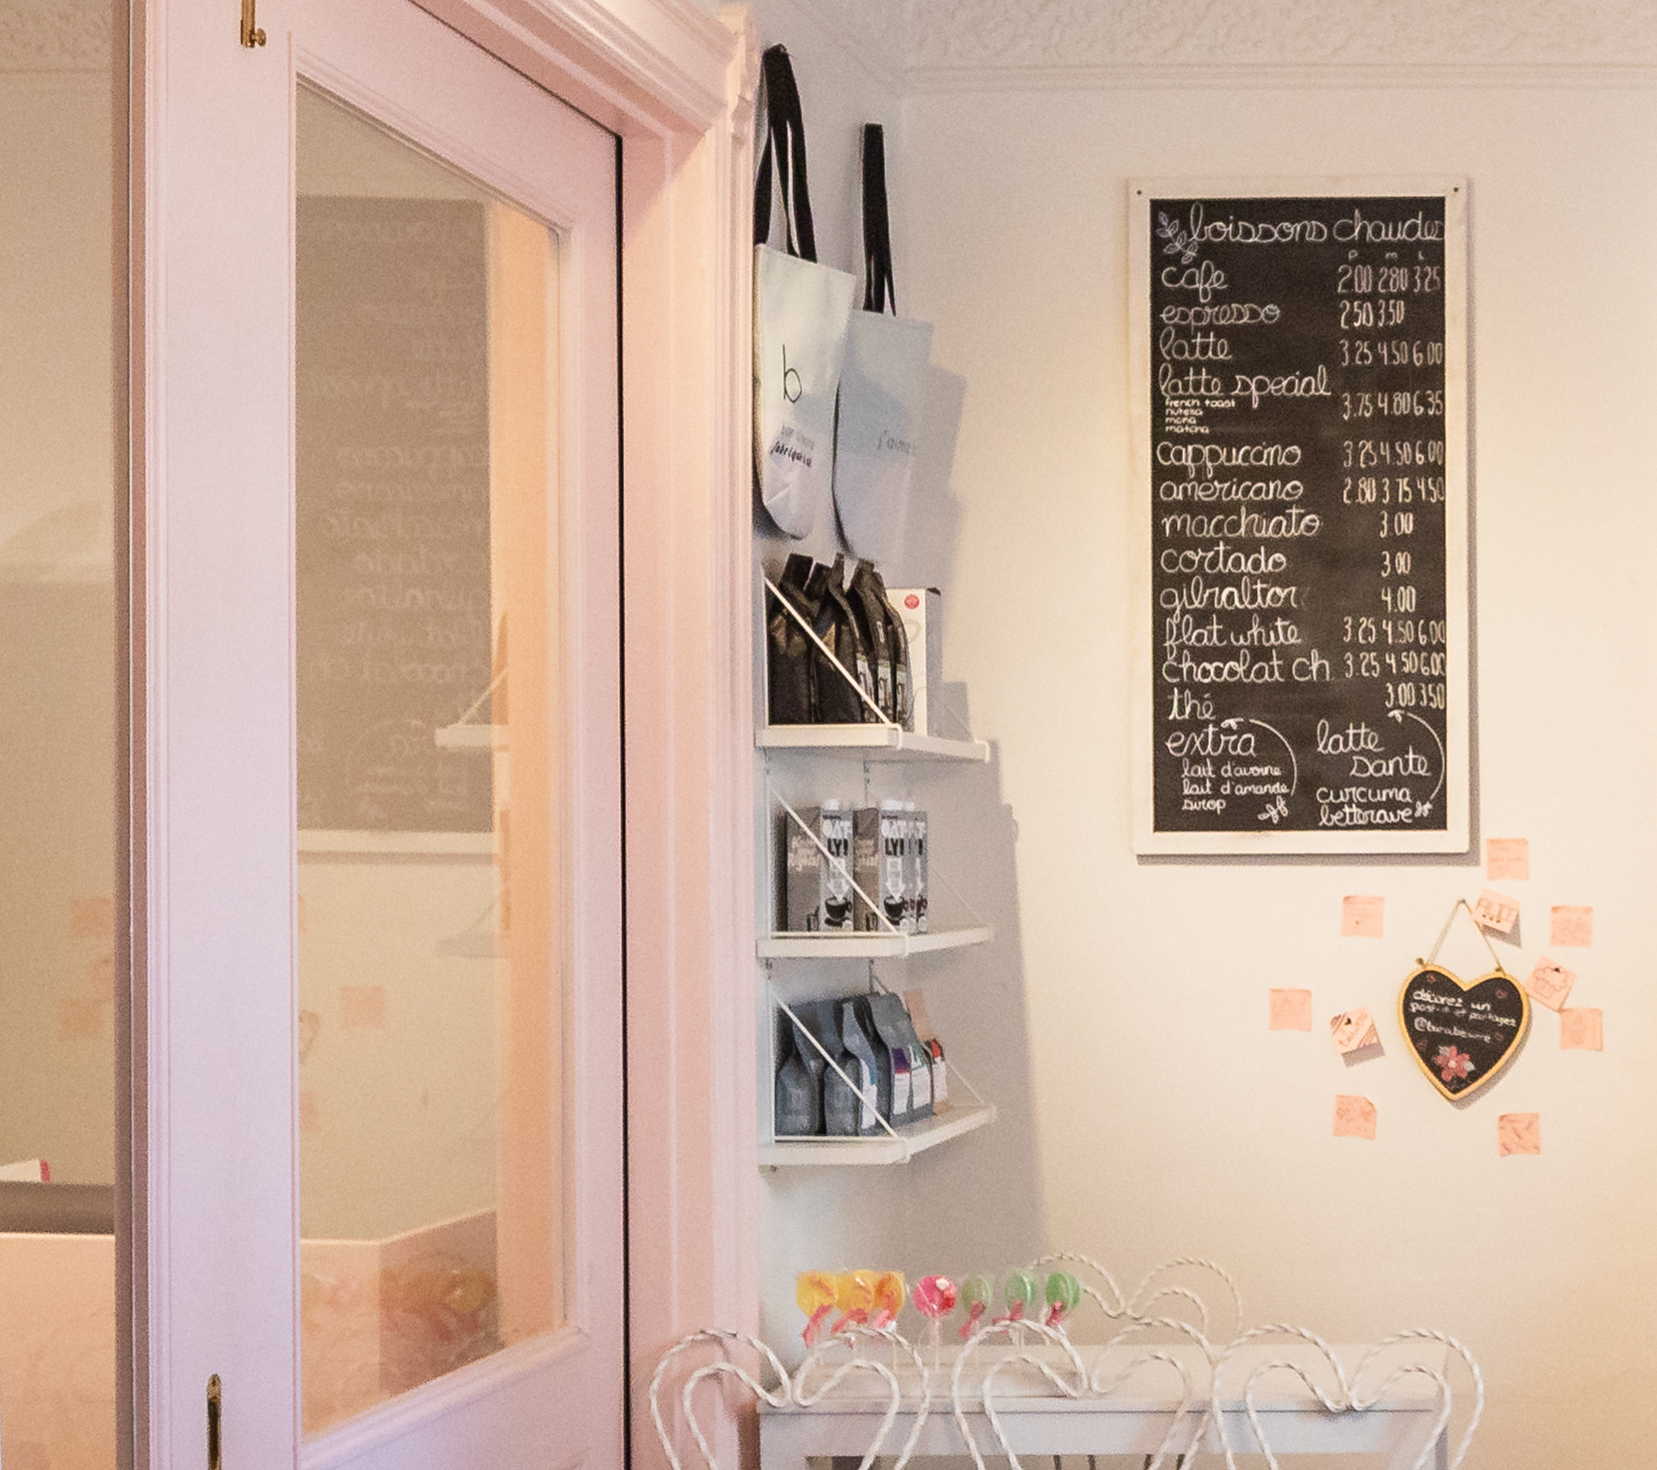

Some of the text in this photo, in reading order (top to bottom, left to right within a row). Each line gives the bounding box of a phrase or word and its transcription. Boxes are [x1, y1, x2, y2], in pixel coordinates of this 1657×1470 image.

[1190, 202, 1444, 243] boissons chaudes
[1160, 304, 1280, 336] espresso
[1160, 327, 1232, 360] latte
[783, 344, 802, 403] b
[1159, 363, 1224, 397] latte
[1205, 399, 1235, 407] toast
[1160, 478, 1303, 501] americano
[1161, 504, 1323, 538] macchiato
[1161, 541, 1286, 574] cortado
[1164, 614, 1228, 660] flat
[1231, 615, 1303, 647] white
[1162, 649, 1284, 683] chocolat
[1165, 724, 1257, 757] extra
[1316, 719, 1385, 754] latte
[1182, 759, 1216, 778] lait
[1183, 779, 1212, 795] lait
[1316, 787, 1412, 803] curcuma
[1182, 798, 1226, 814] sirop
